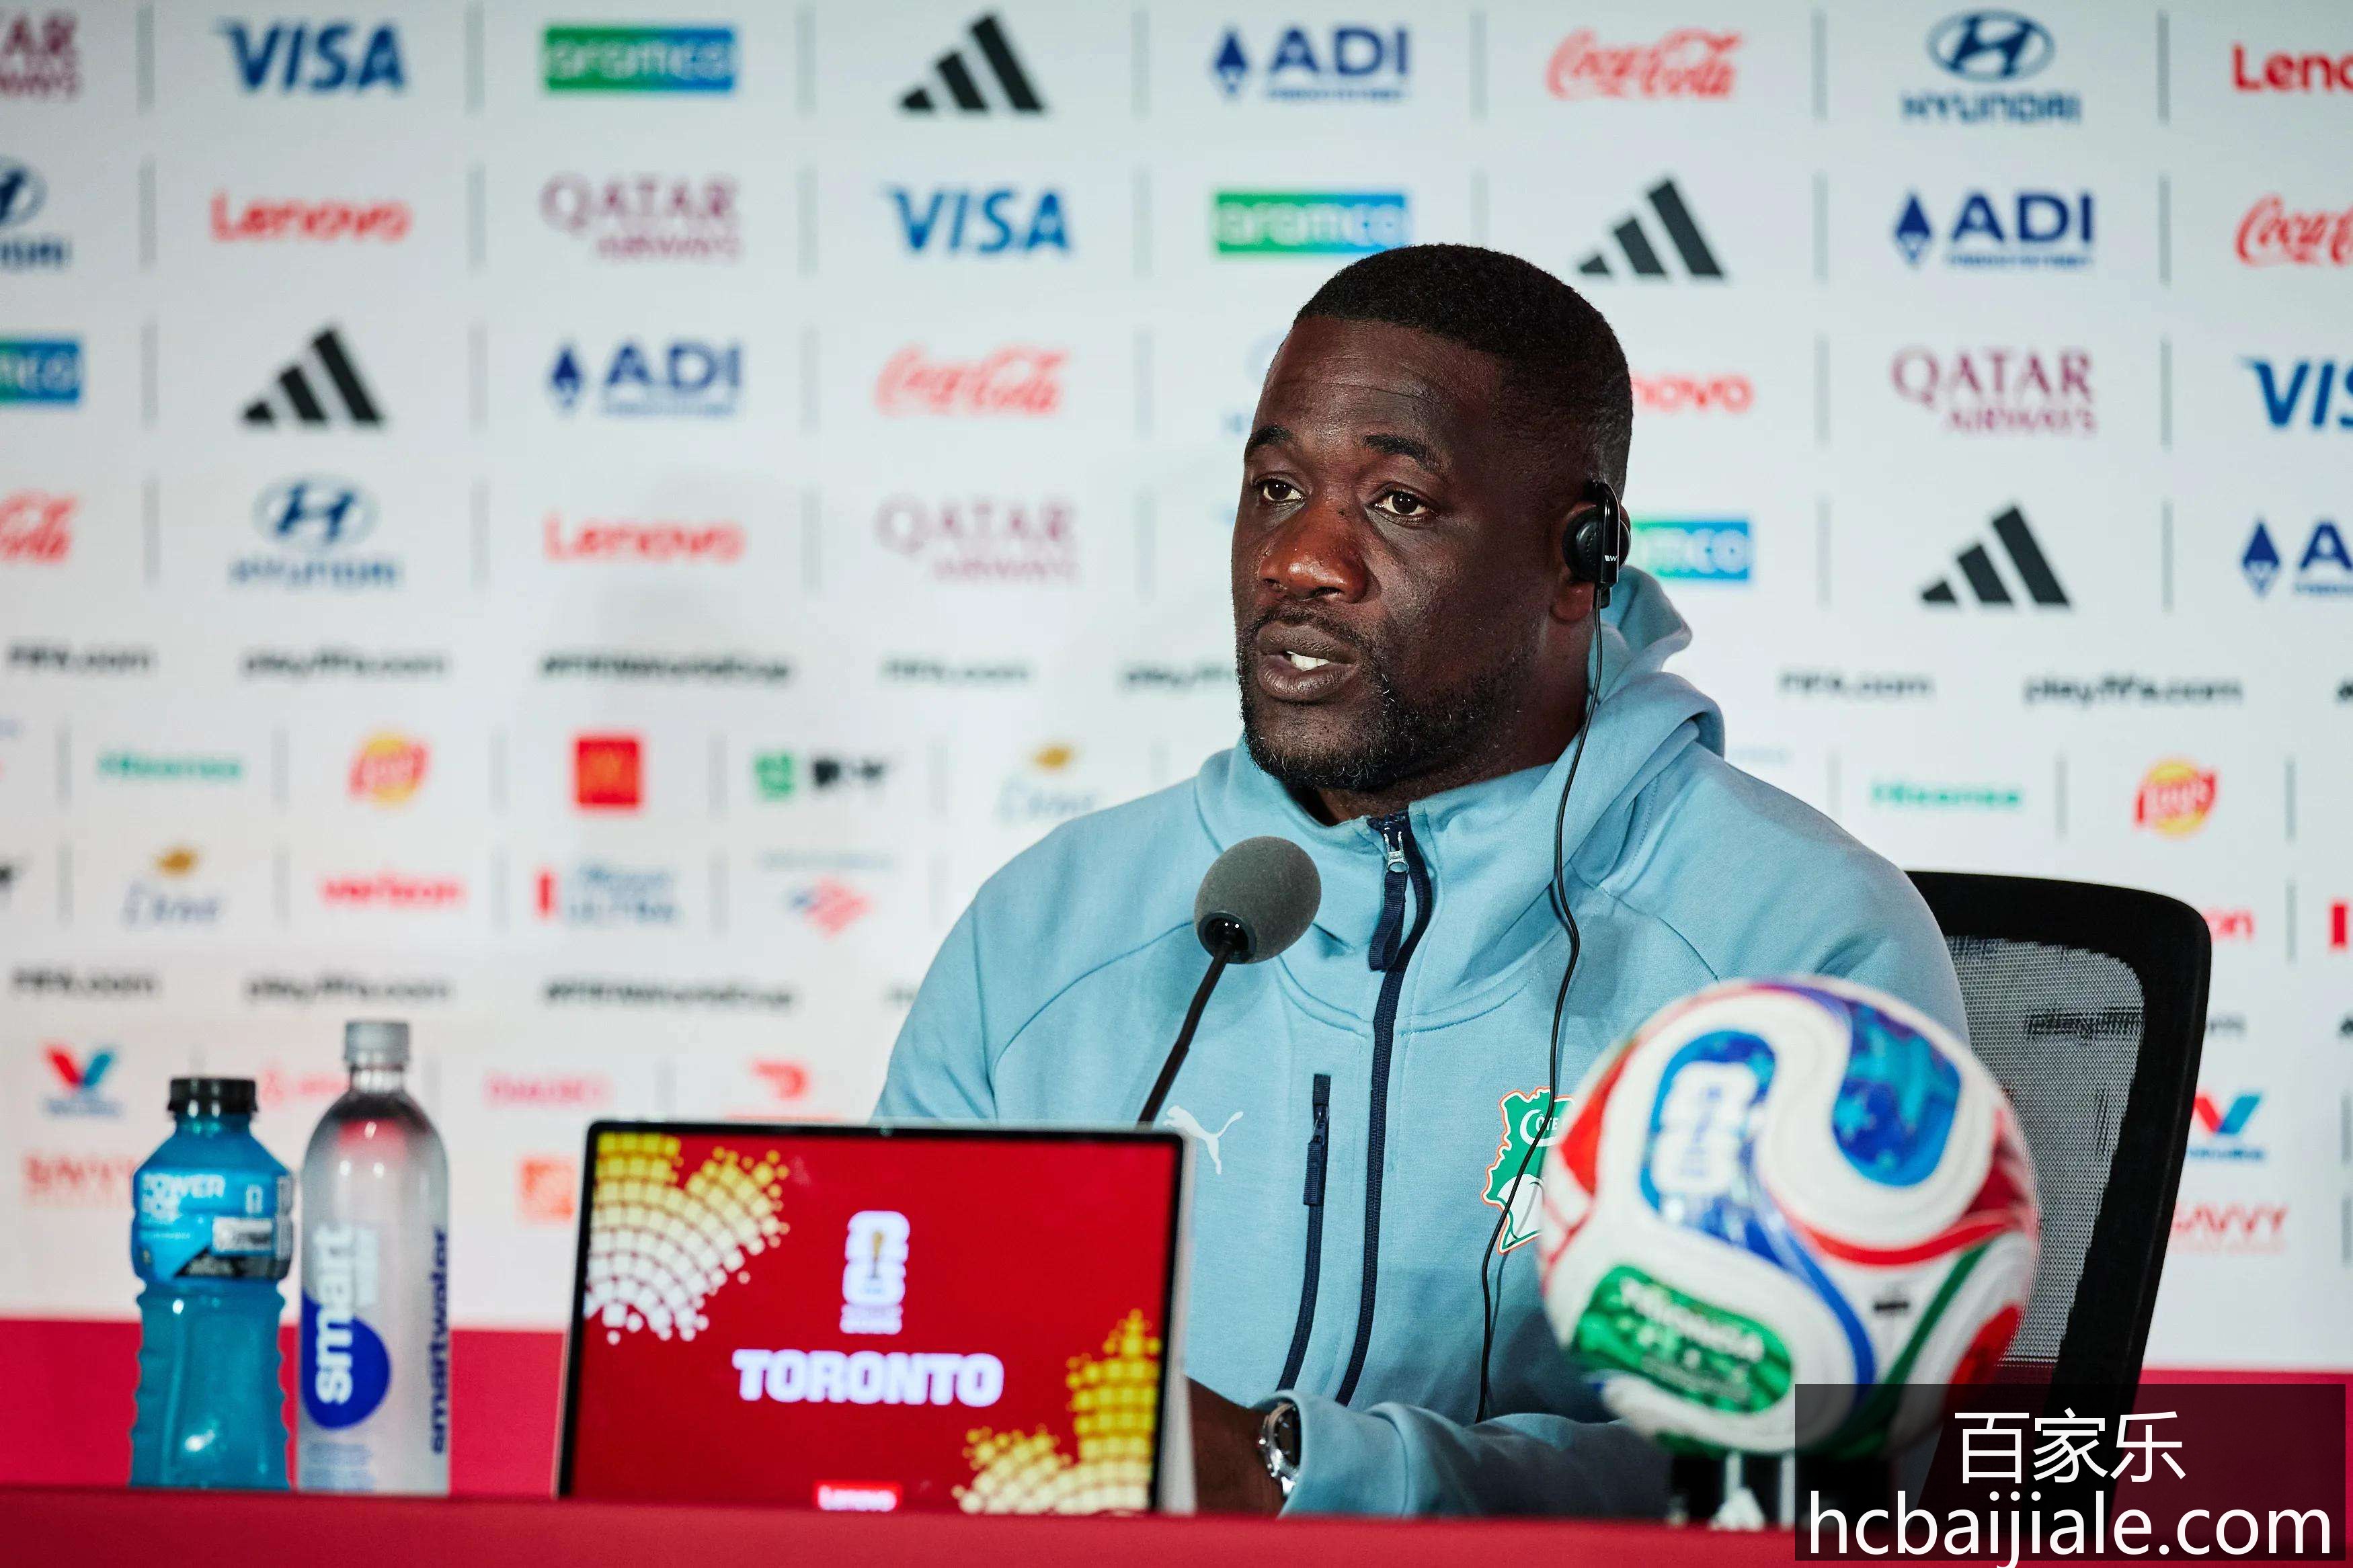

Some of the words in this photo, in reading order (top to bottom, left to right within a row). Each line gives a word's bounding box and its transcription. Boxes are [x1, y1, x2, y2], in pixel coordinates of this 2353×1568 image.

[223, 20, 405, 93] VISA
[1269, 26, 1409, 76] ADI
[1903, 92, 2081, 124] HYUNDAI
[210, 192, 411, 241] Lenovo
[541, 176, 737, 234] QATAR
[887, 187, 1072, 255] VISA
[1213, 202, 1410, 246] aramco
[1950, 191, 2093, 244] ADI
[604, 341, 742, 390] ADI
[1891, 347, 2093, 409] QATAR
[547, 513, 744, 562] Lenovo
[875, 496, 1074, 555] QATAR
[1872, 782, 2024, 811] Hisense
[313, 1225, 355, 1405] smart
[428, 1225, 448, 1455] smartwater
[732, 1348, 1005, 1408] TORONTO
